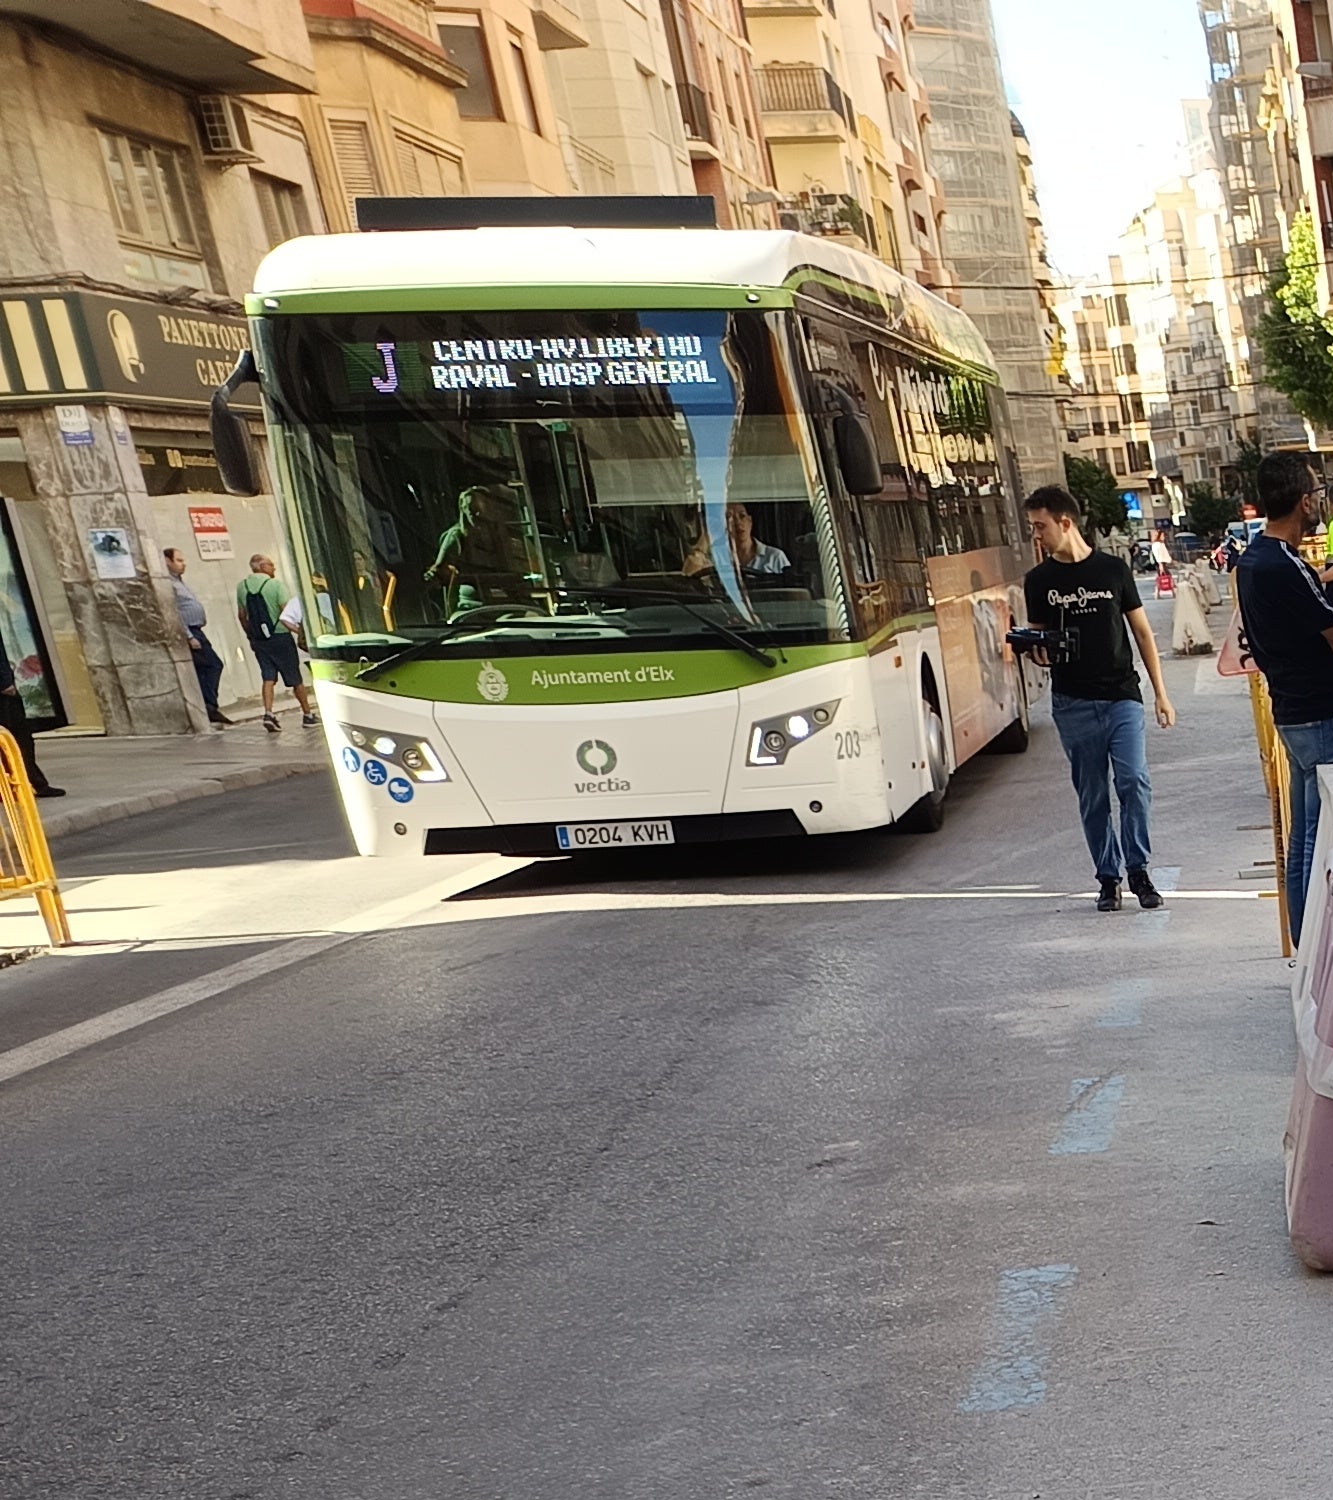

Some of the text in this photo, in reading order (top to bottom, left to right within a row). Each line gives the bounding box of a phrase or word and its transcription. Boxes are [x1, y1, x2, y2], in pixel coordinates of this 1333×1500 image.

[158, 315, 251, 351] PANETTONE
[372, 343, 398, 393] J
[430, 365, 517, 389] RAVAL
[536, 360, 717, 387] HOSP.GENERAL
[1048, 587, 1113, 609] Pepe Jeans
[531, 670, 632, 689] Ajuntament
[835, 730, 861, 760] 203
[574, 778, 631, 793] vectia
[574, 824, 669, 845] 0204 KVH
